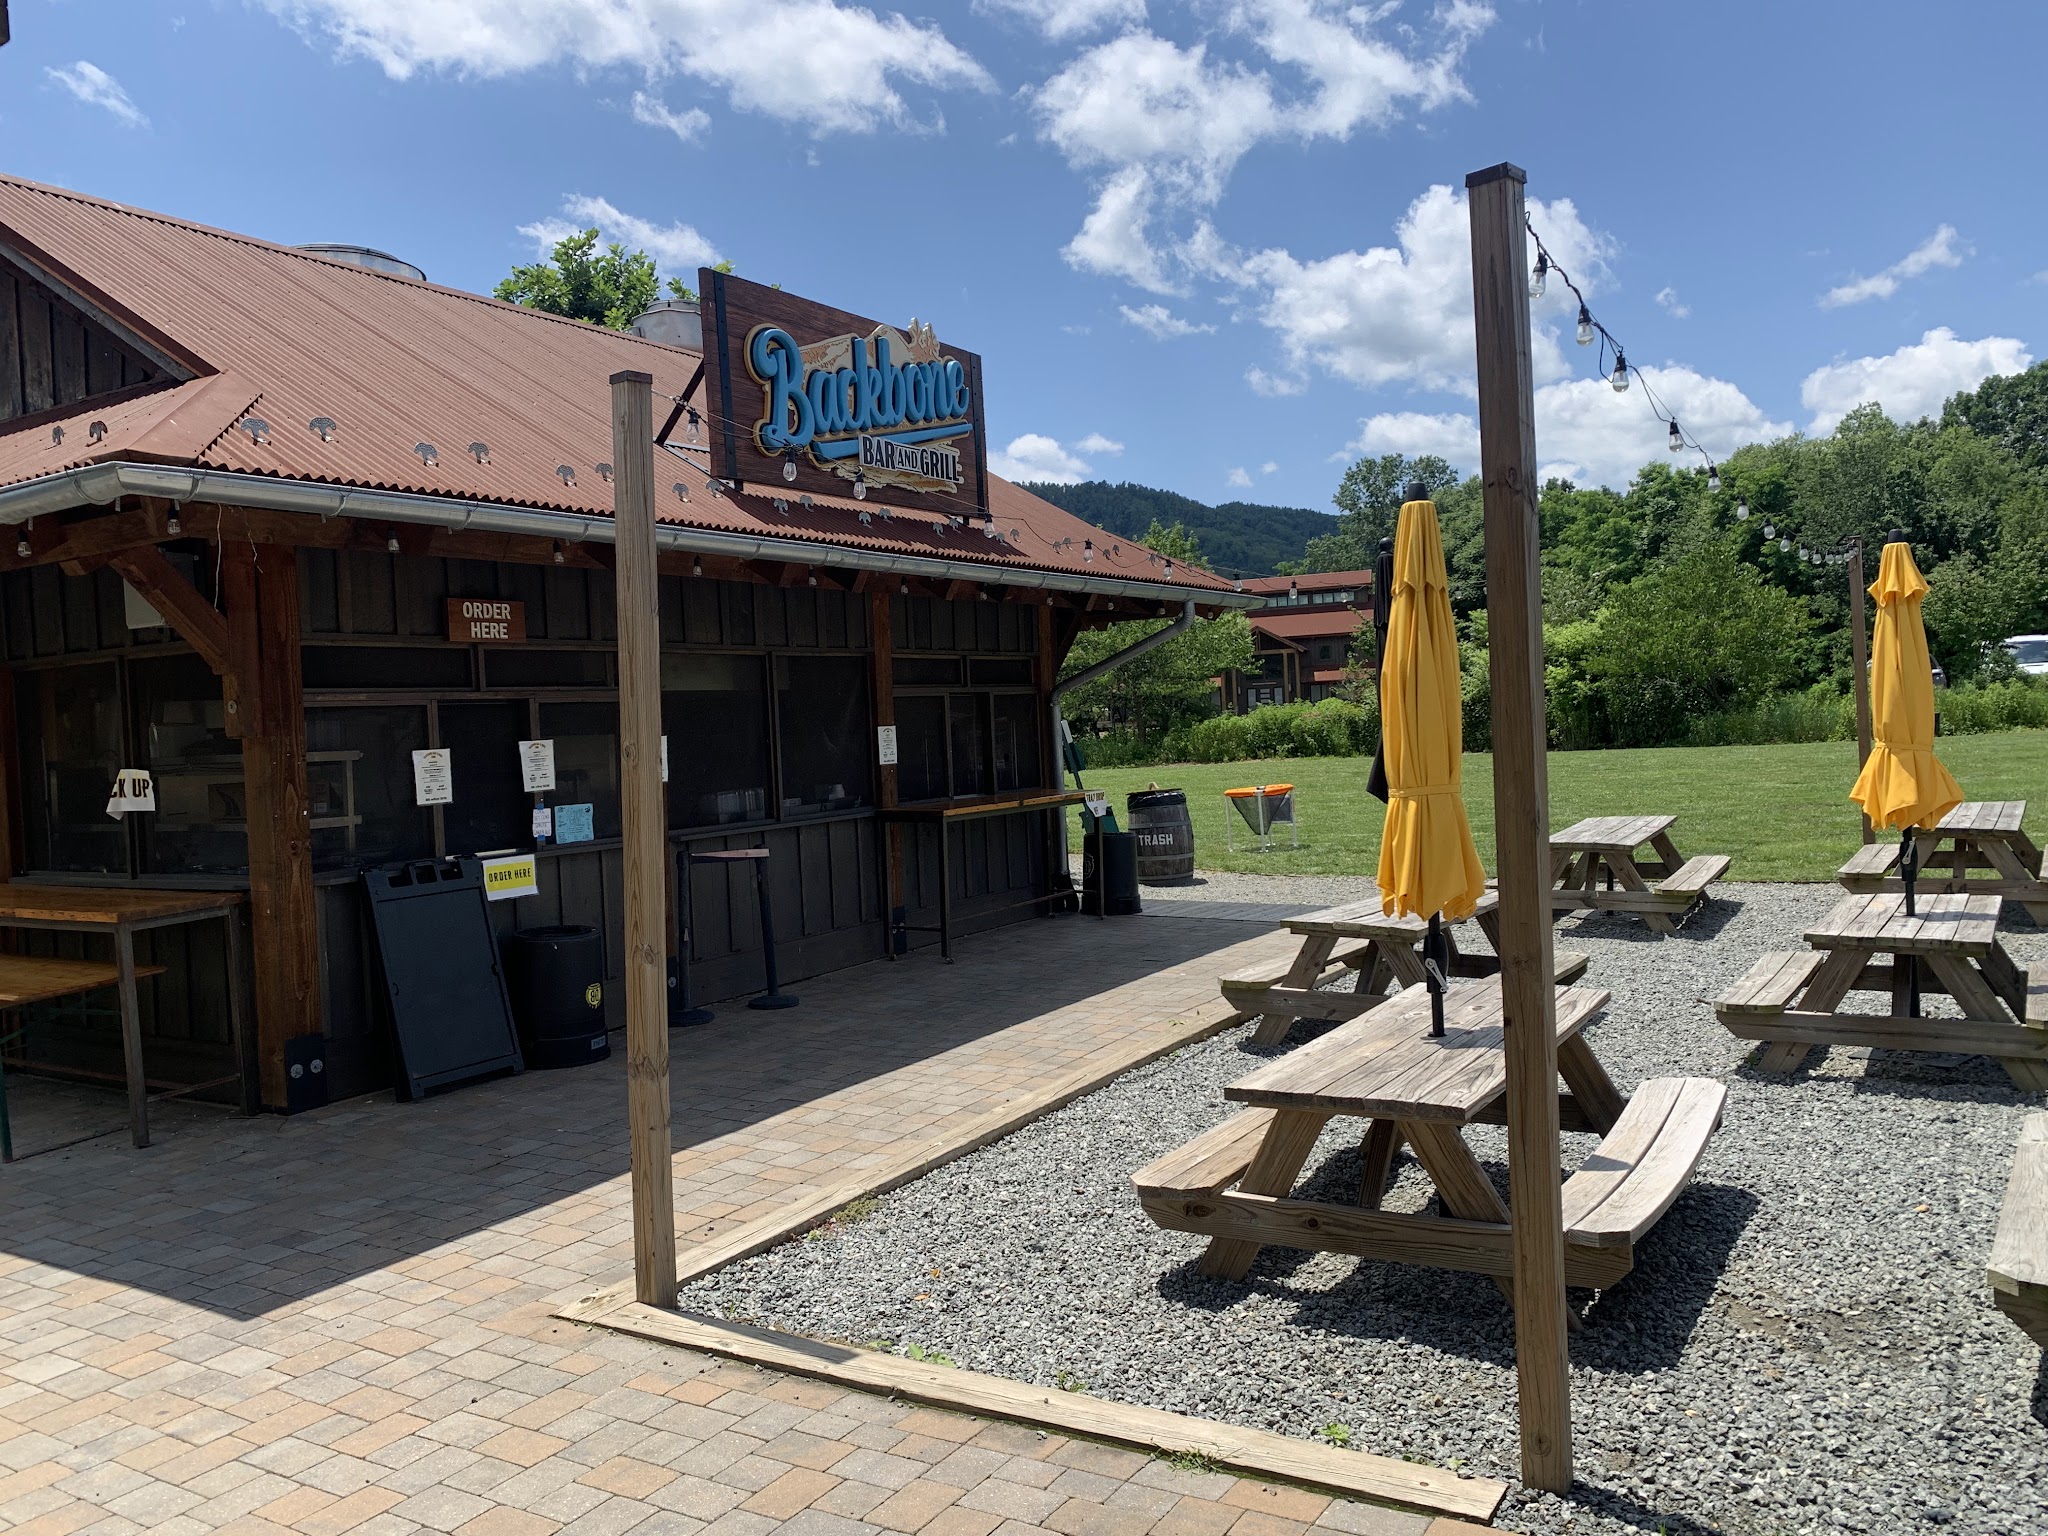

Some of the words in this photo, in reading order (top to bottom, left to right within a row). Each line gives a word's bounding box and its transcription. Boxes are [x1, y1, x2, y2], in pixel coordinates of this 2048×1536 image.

[753, 329, 970, 447] Backbone
[862, 436, 896, 470] BAR
[897, 446, 918, 470] AND
[920, 448, 960, 481] GRILL
[462, 601, 511, 619] ORDER
[470, 621, 509, 639] HERE
[132, 778, 150, 798] UP
[1138, 833, 1174, 846] TRASH
[488, 870, 512, 882] ORDER
[514, 868, 531, 879] HERE
